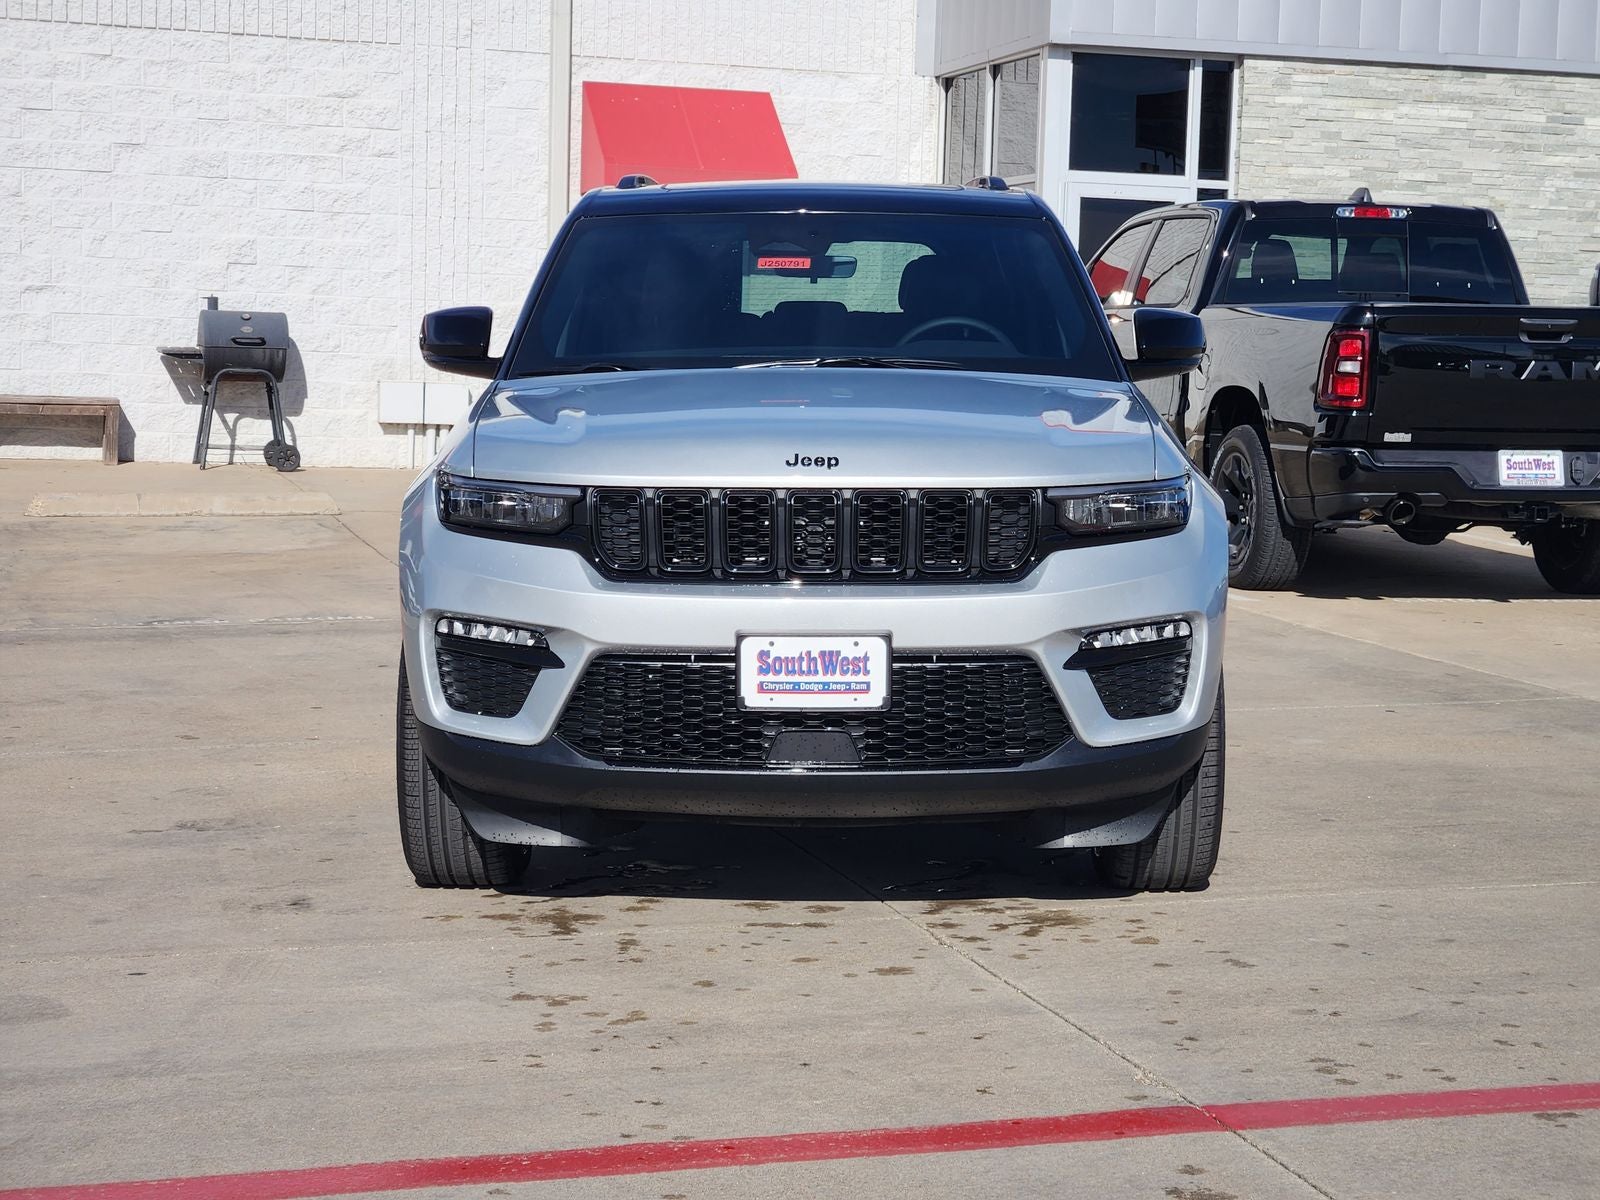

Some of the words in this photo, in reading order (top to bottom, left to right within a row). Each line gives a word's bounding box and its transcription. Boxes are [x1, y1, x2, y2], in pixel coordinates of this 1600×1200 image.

[785, 453, 840, 470] Jeep
[1506, 458, 1555, 471] SouthWest
[757, 649, 871, 677] SouthWest
[763, 682, 793, 691] Chrysler
[800, 682, 823, 691] Dodge
[829, 682, 846, 691] Jeep
[850, 682, 867, 690] Ram
